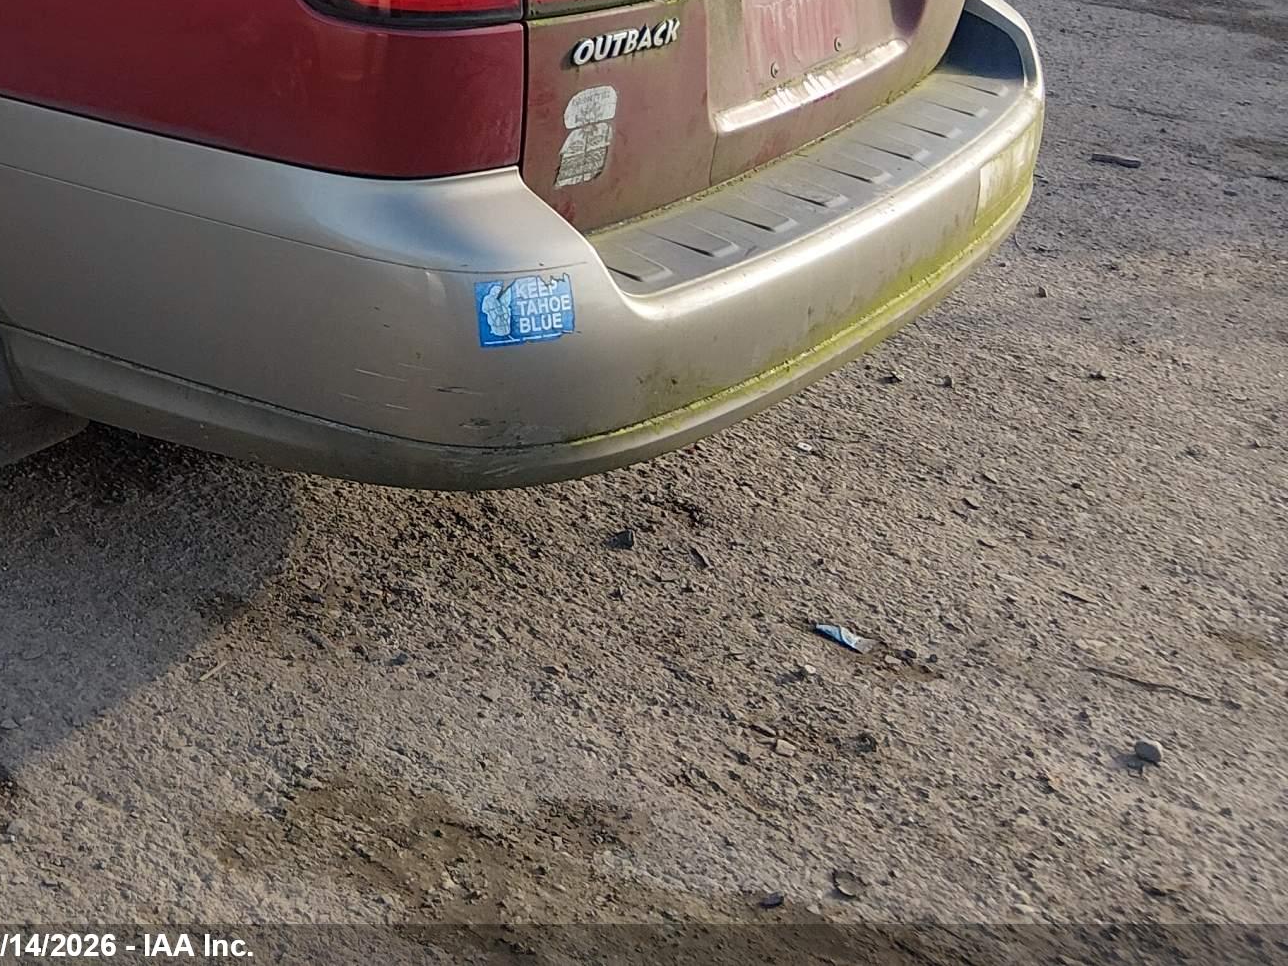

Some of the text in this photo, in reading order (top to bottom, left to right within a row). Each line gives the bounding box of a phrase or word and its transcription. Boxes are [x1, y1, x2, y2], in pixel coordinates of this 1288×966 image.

[572, 18, 680, 66] OUTBACK
[515, 277, 558, 299] KEEP
[517, 294, 571, 316] TAHOE
[519, 313, 563, 334] BLUE
